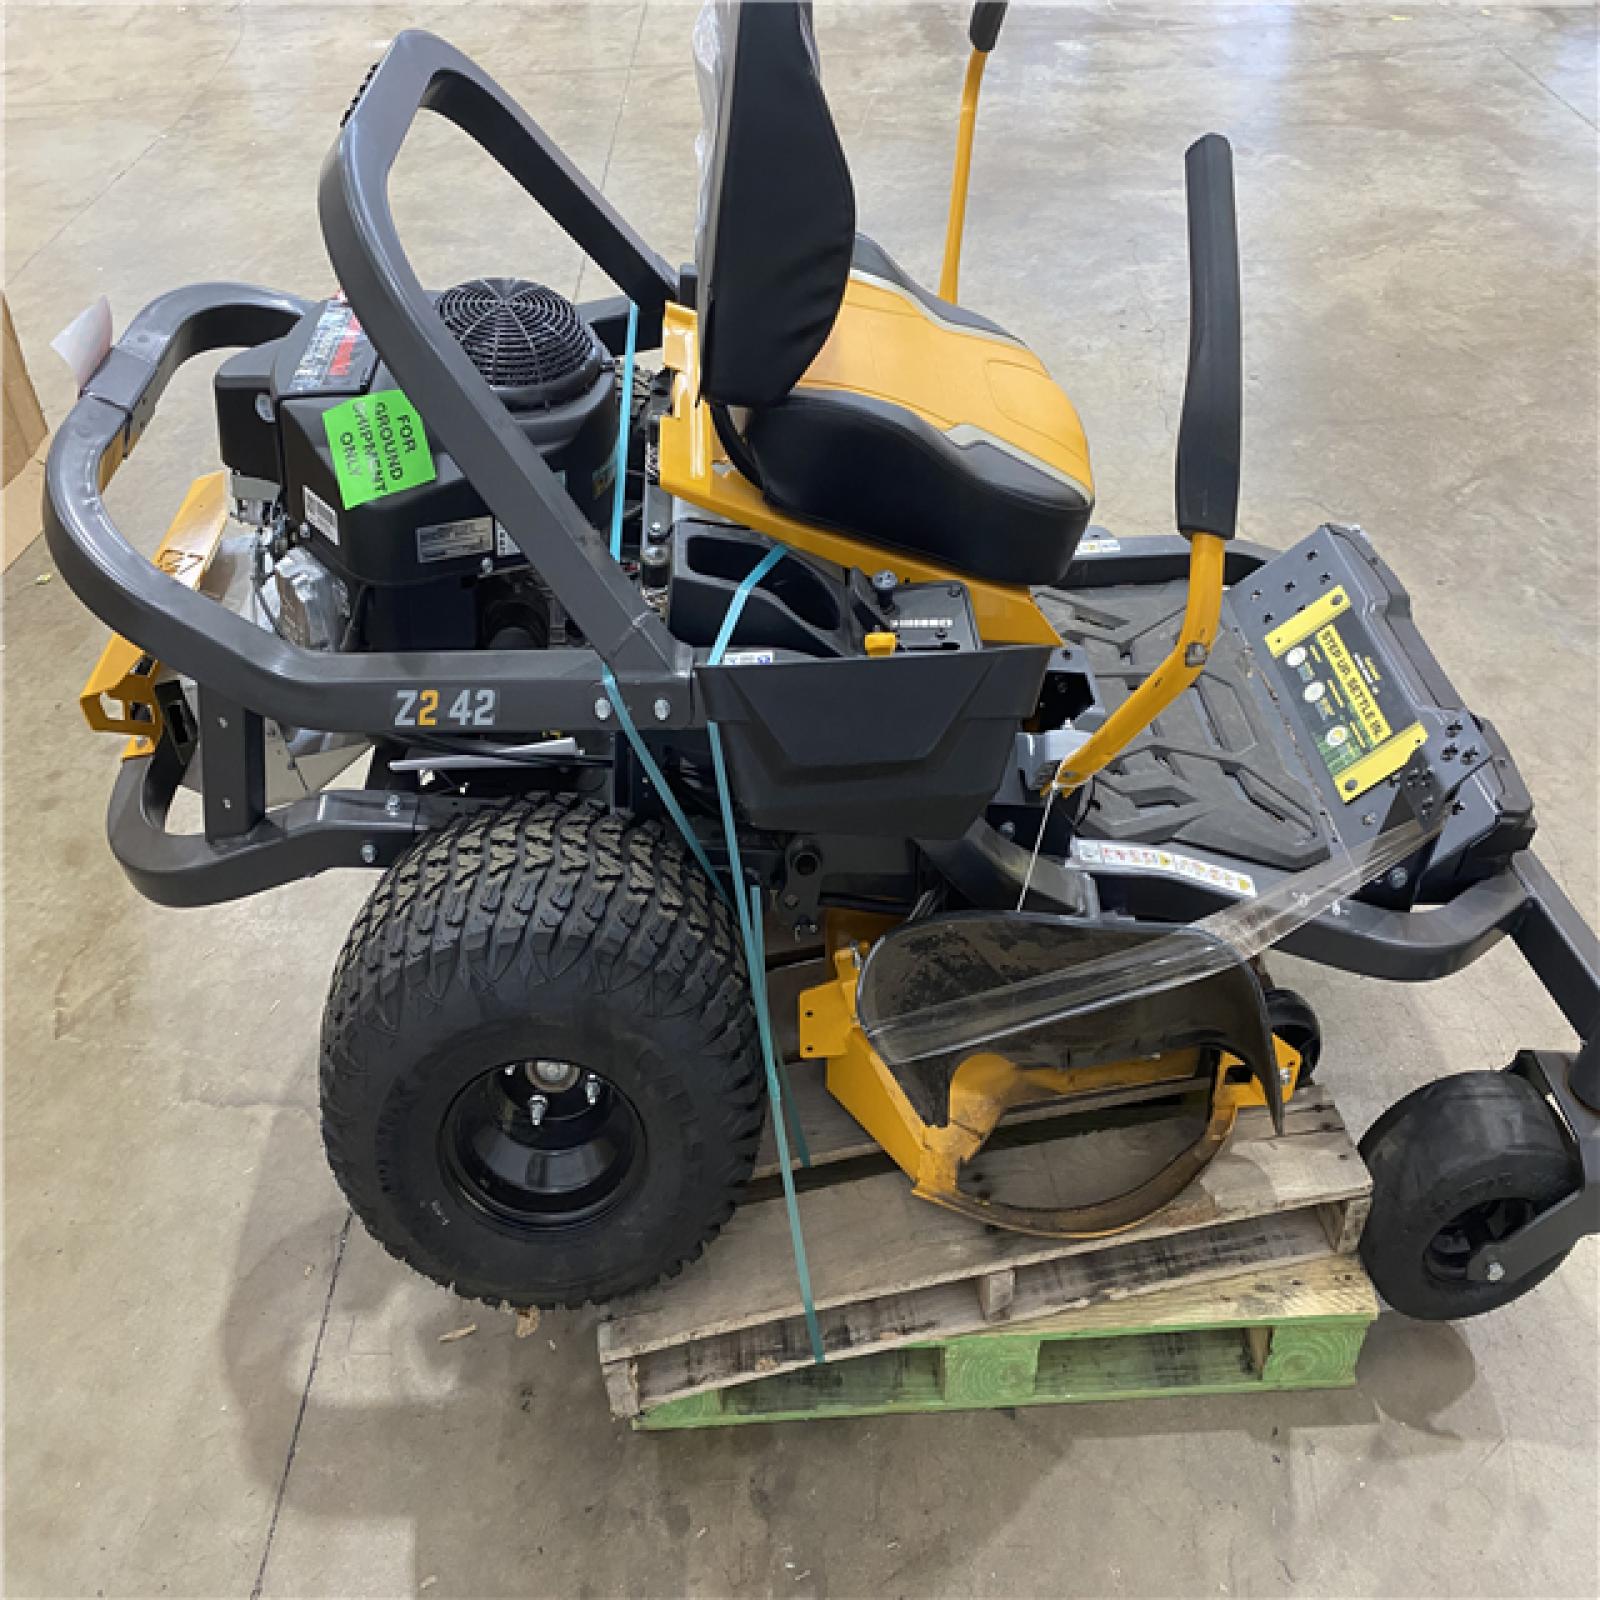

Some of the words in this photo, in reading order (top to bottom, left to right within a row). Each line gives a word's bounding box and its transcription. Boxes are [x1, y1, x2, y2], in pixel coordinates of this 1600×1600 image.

[340, 432, 362, 475] ONLY
[375, 402, 404, 481] GROUND
[397, 414, 416, 454] FOR
[1321, 629, 1342, 658] STEP
[1348, 677, 1376, 721] SETTLE
[394, 689, 439, 726] Z2
[449, 689, 496, 726] 42
